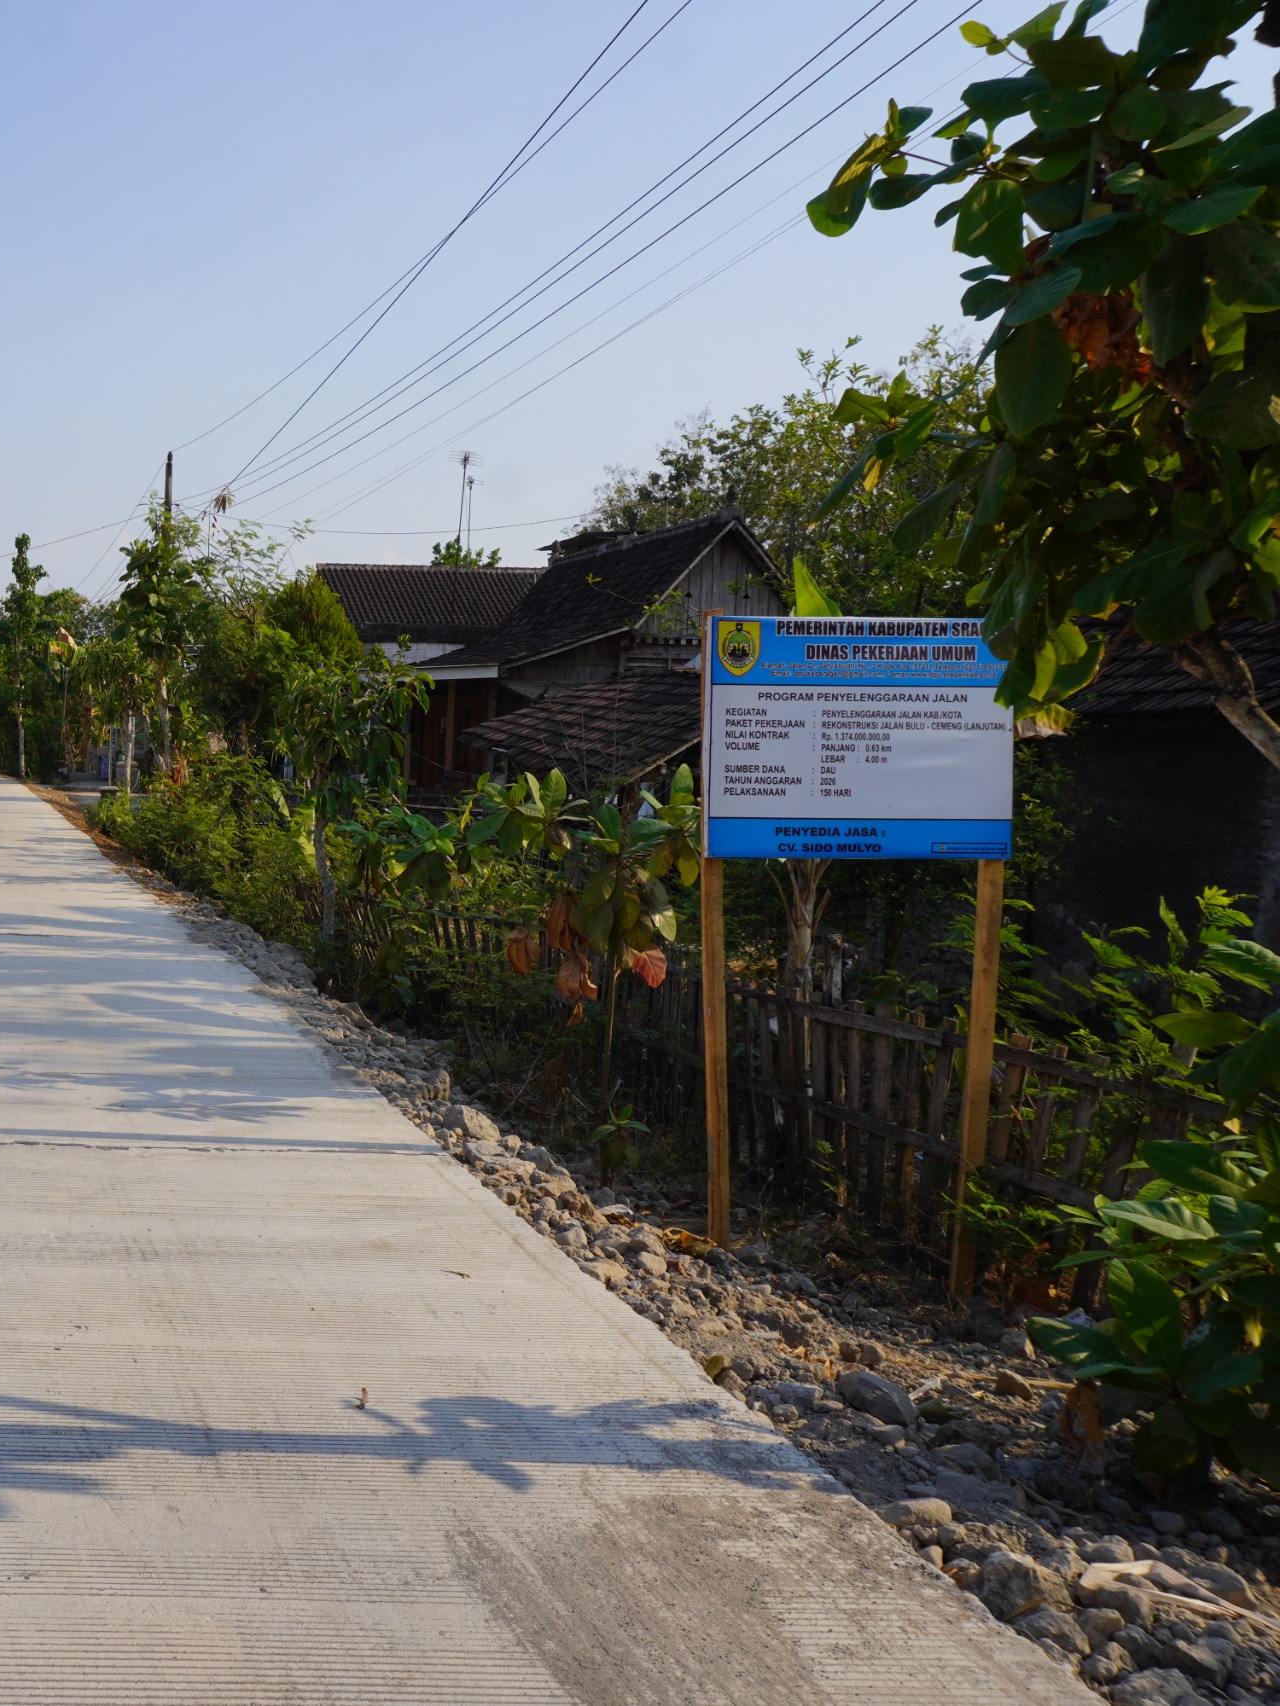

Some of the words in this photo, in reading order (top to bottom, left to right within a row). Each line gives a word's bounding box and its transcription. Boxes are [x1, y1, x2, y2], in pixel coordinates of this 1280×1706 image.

[776, 620, 865, 636] PEMERINTAH
[868, 621, 948, 637] KABUPATEN
[951, 622, 983, 637] SRA
[805, 644, 848, 660] DINAS
[851, 645, 928, 660] PEKERJAAN
[931, 645, 976, 661] UMUM
[758, 692, 814, 701] PROGRAM
[817, 692, 929, 703] PENYELENGGARAAN
[932, 693, 968, 703] JALAN
[725, 708, 768, 717] KEGIATAN
[821, 710, 896, 718] PENYELENGGARAAN
[898, 711, 922, 719] JALAN
[923, 711, 962, 719] KAB./KOTA
[725, 719, 753, 728] PAKET
[755, 719, 805, 728] PEKERJAAN
[821, 721, 878, 730] REKONSTRUKSI
[880, 722, 904, 730] JALAN
[905, 722, 925, 730] BULU
[931, 722, 962, 730] CEMENG
[964, 722, 1006, 731] (LANJUTAN)
[725, 730, 747, 739] NILAI
[748, 730, 790, 739] KONTRAK
[821, 733, 833, 742] Rp.
[725, 742, 760, 750] VOLUME
[821, 744, 856, 752] PANJANG
[865, 744, 880, 752] 0.63
[881, 744, 892, 752] km
[821, 755, 846, 763] LEBAR
[865, 755, 880, 763] 4.00
[724, 765, 760, 773] SUMBER
[762, 765, 785, 774] DANA
[820, 766, 836, 774] DAU
[724, 776, 752, 785] TAHUN
[754, 776, 802, 785] ANGGARAN
[723, 787, 786, 796] PELAKSANAAN
[820, 789, 832, 797] 150
[833, 789, 852, 797] HARI
[775, 827, 840, 837] PENYEDIA
[844, 828, 878, 837] JASA
[777, 843, 798, 852] CV.
[801, 843, 833, 852] SIDO
[836, 843, 882, 853] MULYO
